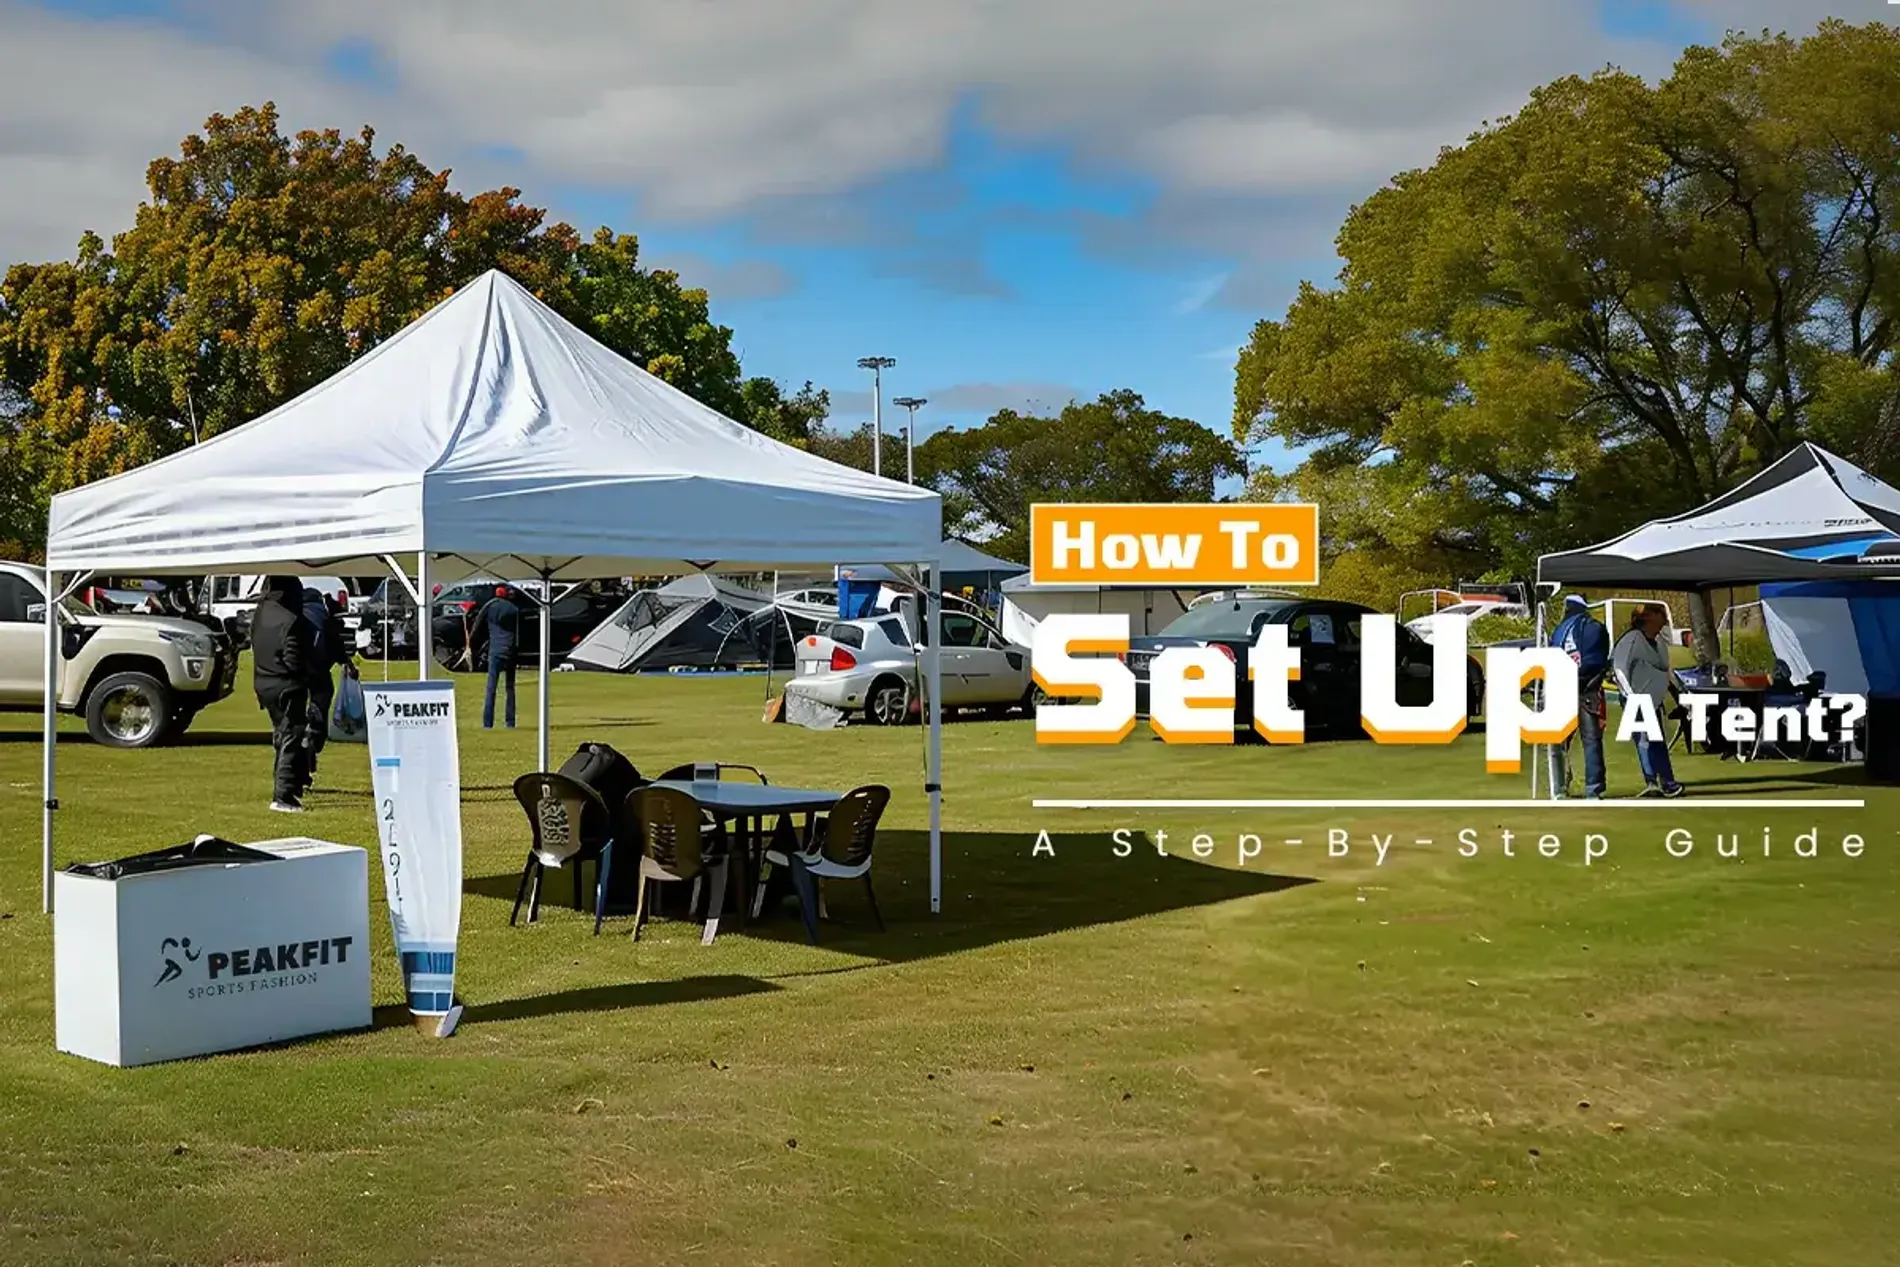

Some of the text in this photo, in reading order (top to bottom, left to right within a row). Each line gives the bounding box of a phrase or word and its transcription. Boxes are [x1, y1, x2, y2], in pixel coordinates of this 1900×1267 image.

[393, 702, 449, 717] PEAKFIT
[207, 937, 353, 979] PEAKFIT
[188, 971, 318, 999] SPORTS FASHION
